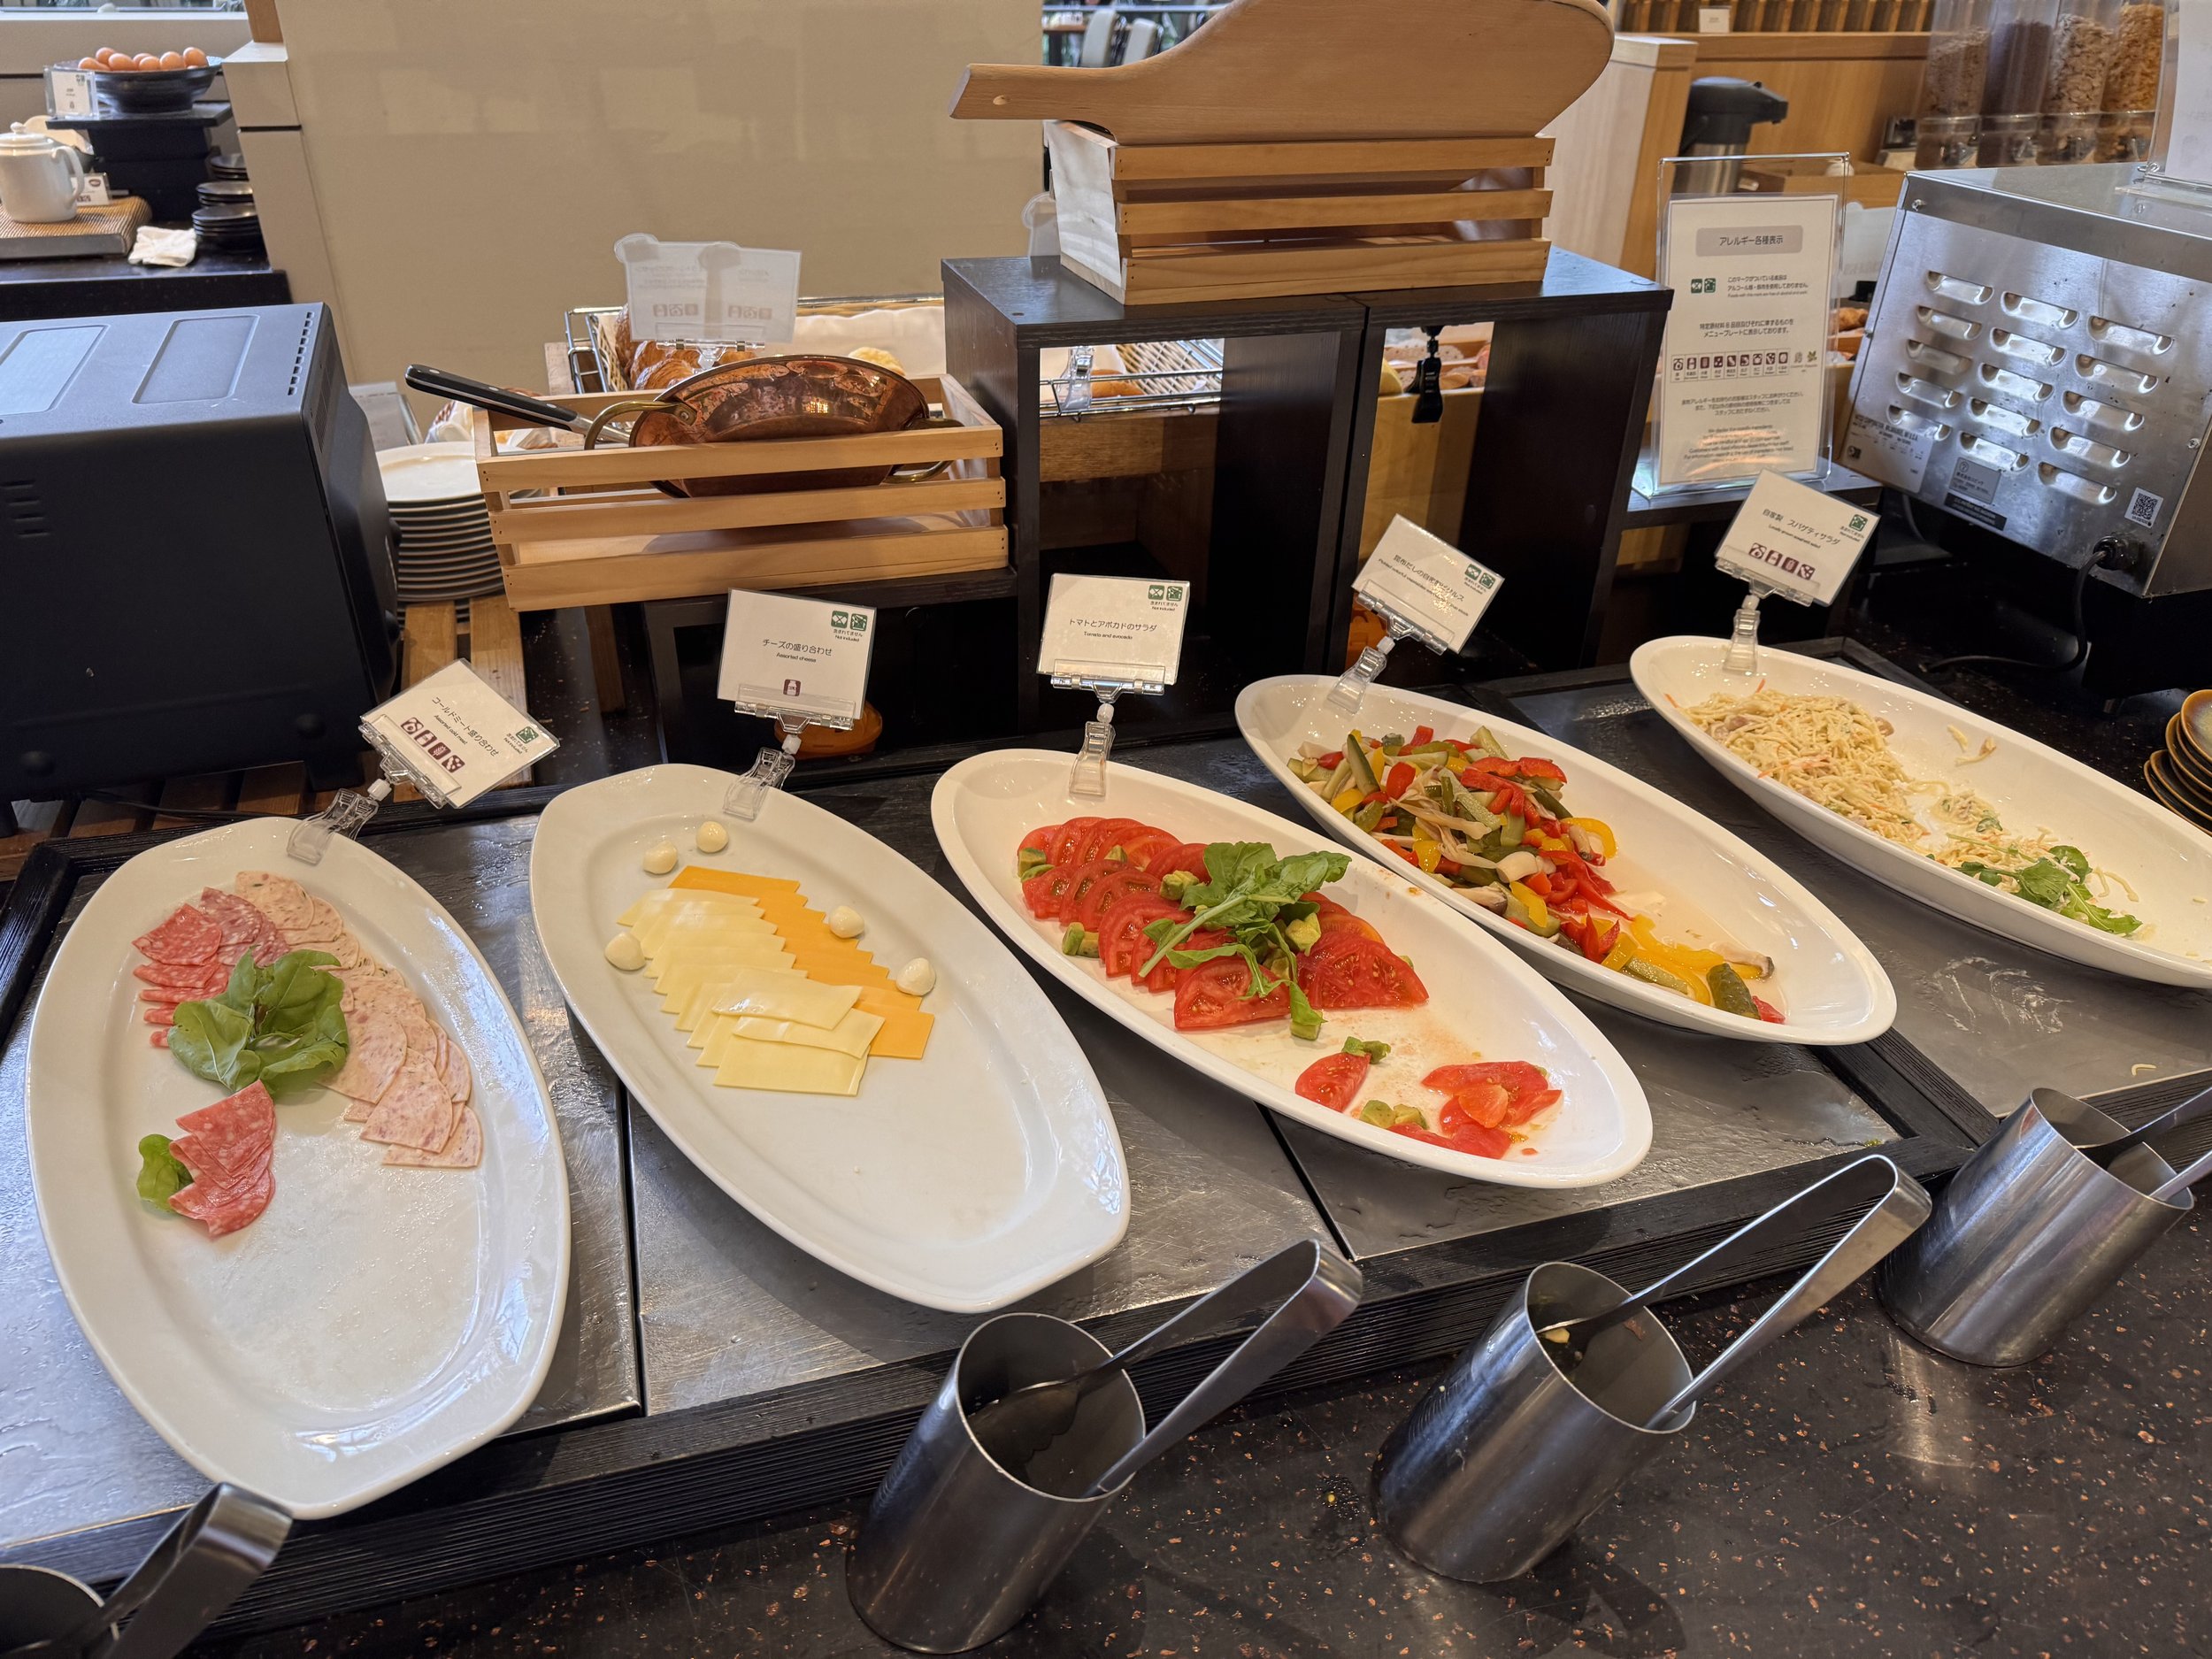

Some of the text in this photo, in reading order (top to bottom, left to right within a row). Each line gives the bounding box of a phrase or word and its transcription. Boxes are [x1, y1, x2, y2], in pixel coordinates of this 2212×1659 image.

[1720, 235, 1783, 246] アレルギー各種表示
[1070, 618, 1156, 632] トマトとアボカドのサラダ
[763, 639, 832, 657] チーズの盛り合わせ
[432, 696, 499, 757] コールドミート盛り合わせ
[434, 715, 450, 730] Assorted
[457, 735, 467, 745] meat
